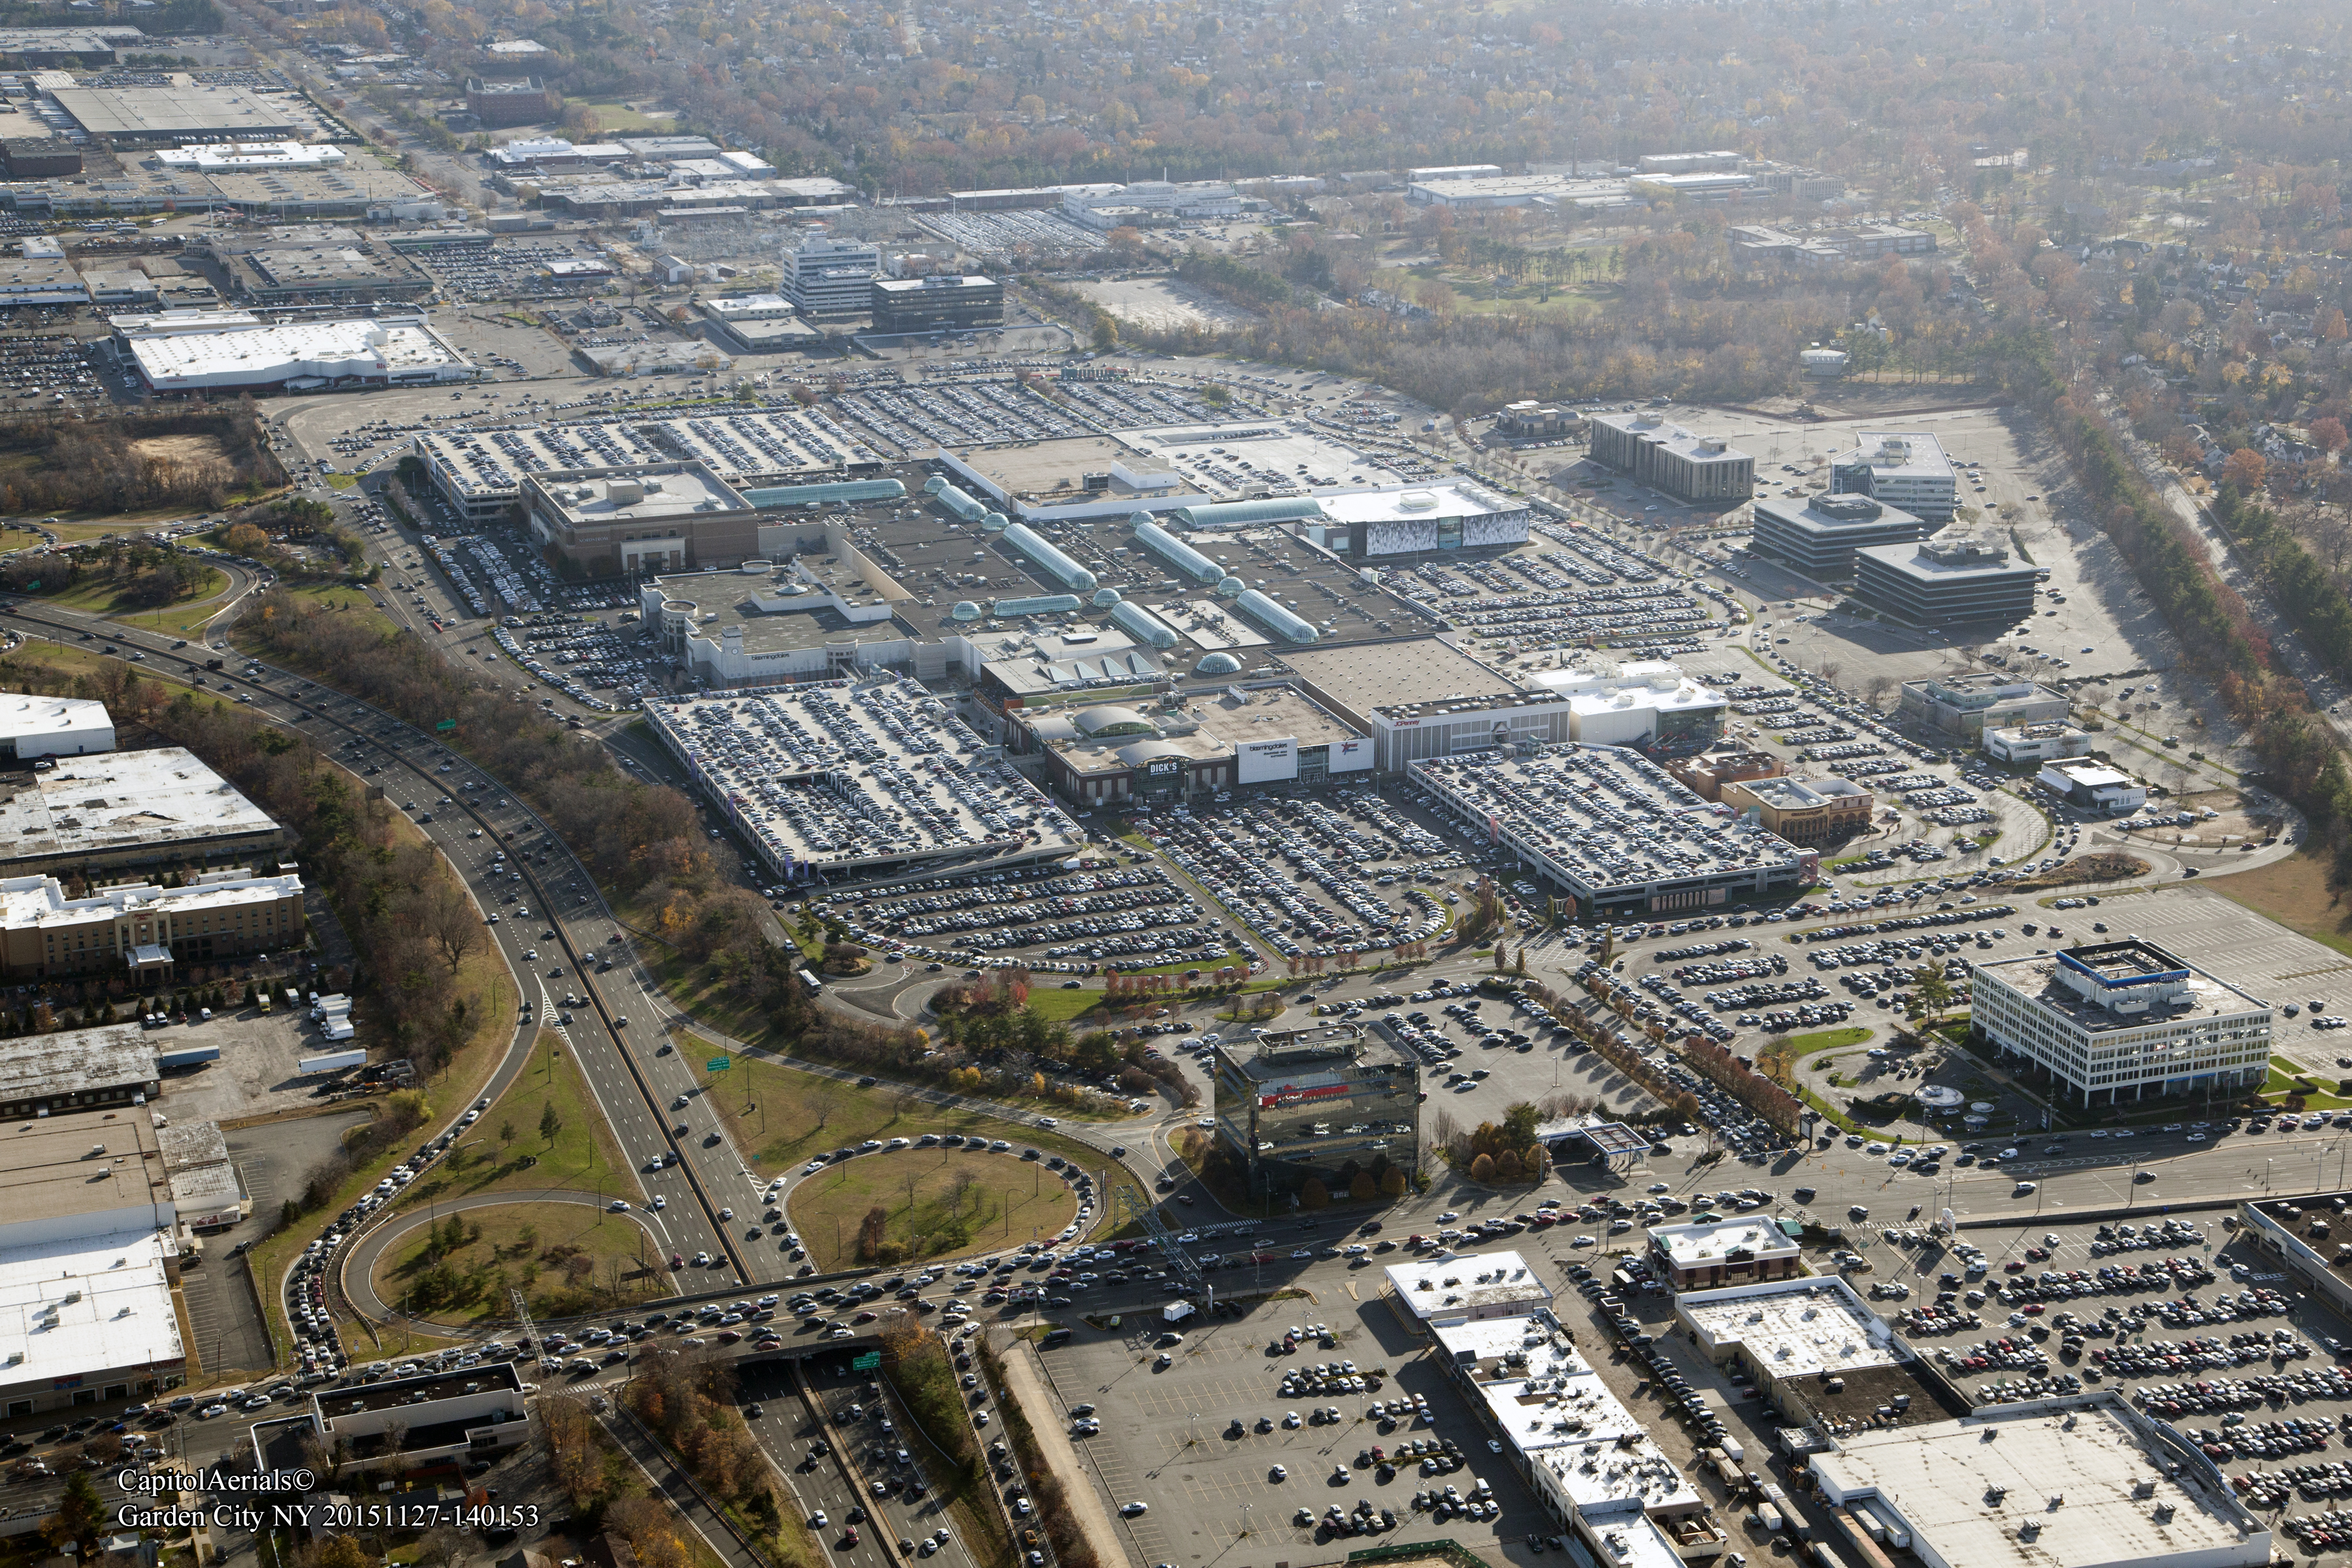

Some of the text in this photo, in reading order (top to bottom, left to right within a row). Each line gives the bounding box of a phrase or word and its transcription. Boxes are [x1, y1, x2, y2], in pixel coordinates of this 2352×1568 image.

[1151, 762, 1177, 773] DICK'S
[2089, 972, 2107, 987] citibank
[2160, 972, 2187, 981] citibank
[1311, 1043, 1326, 1052] 666
